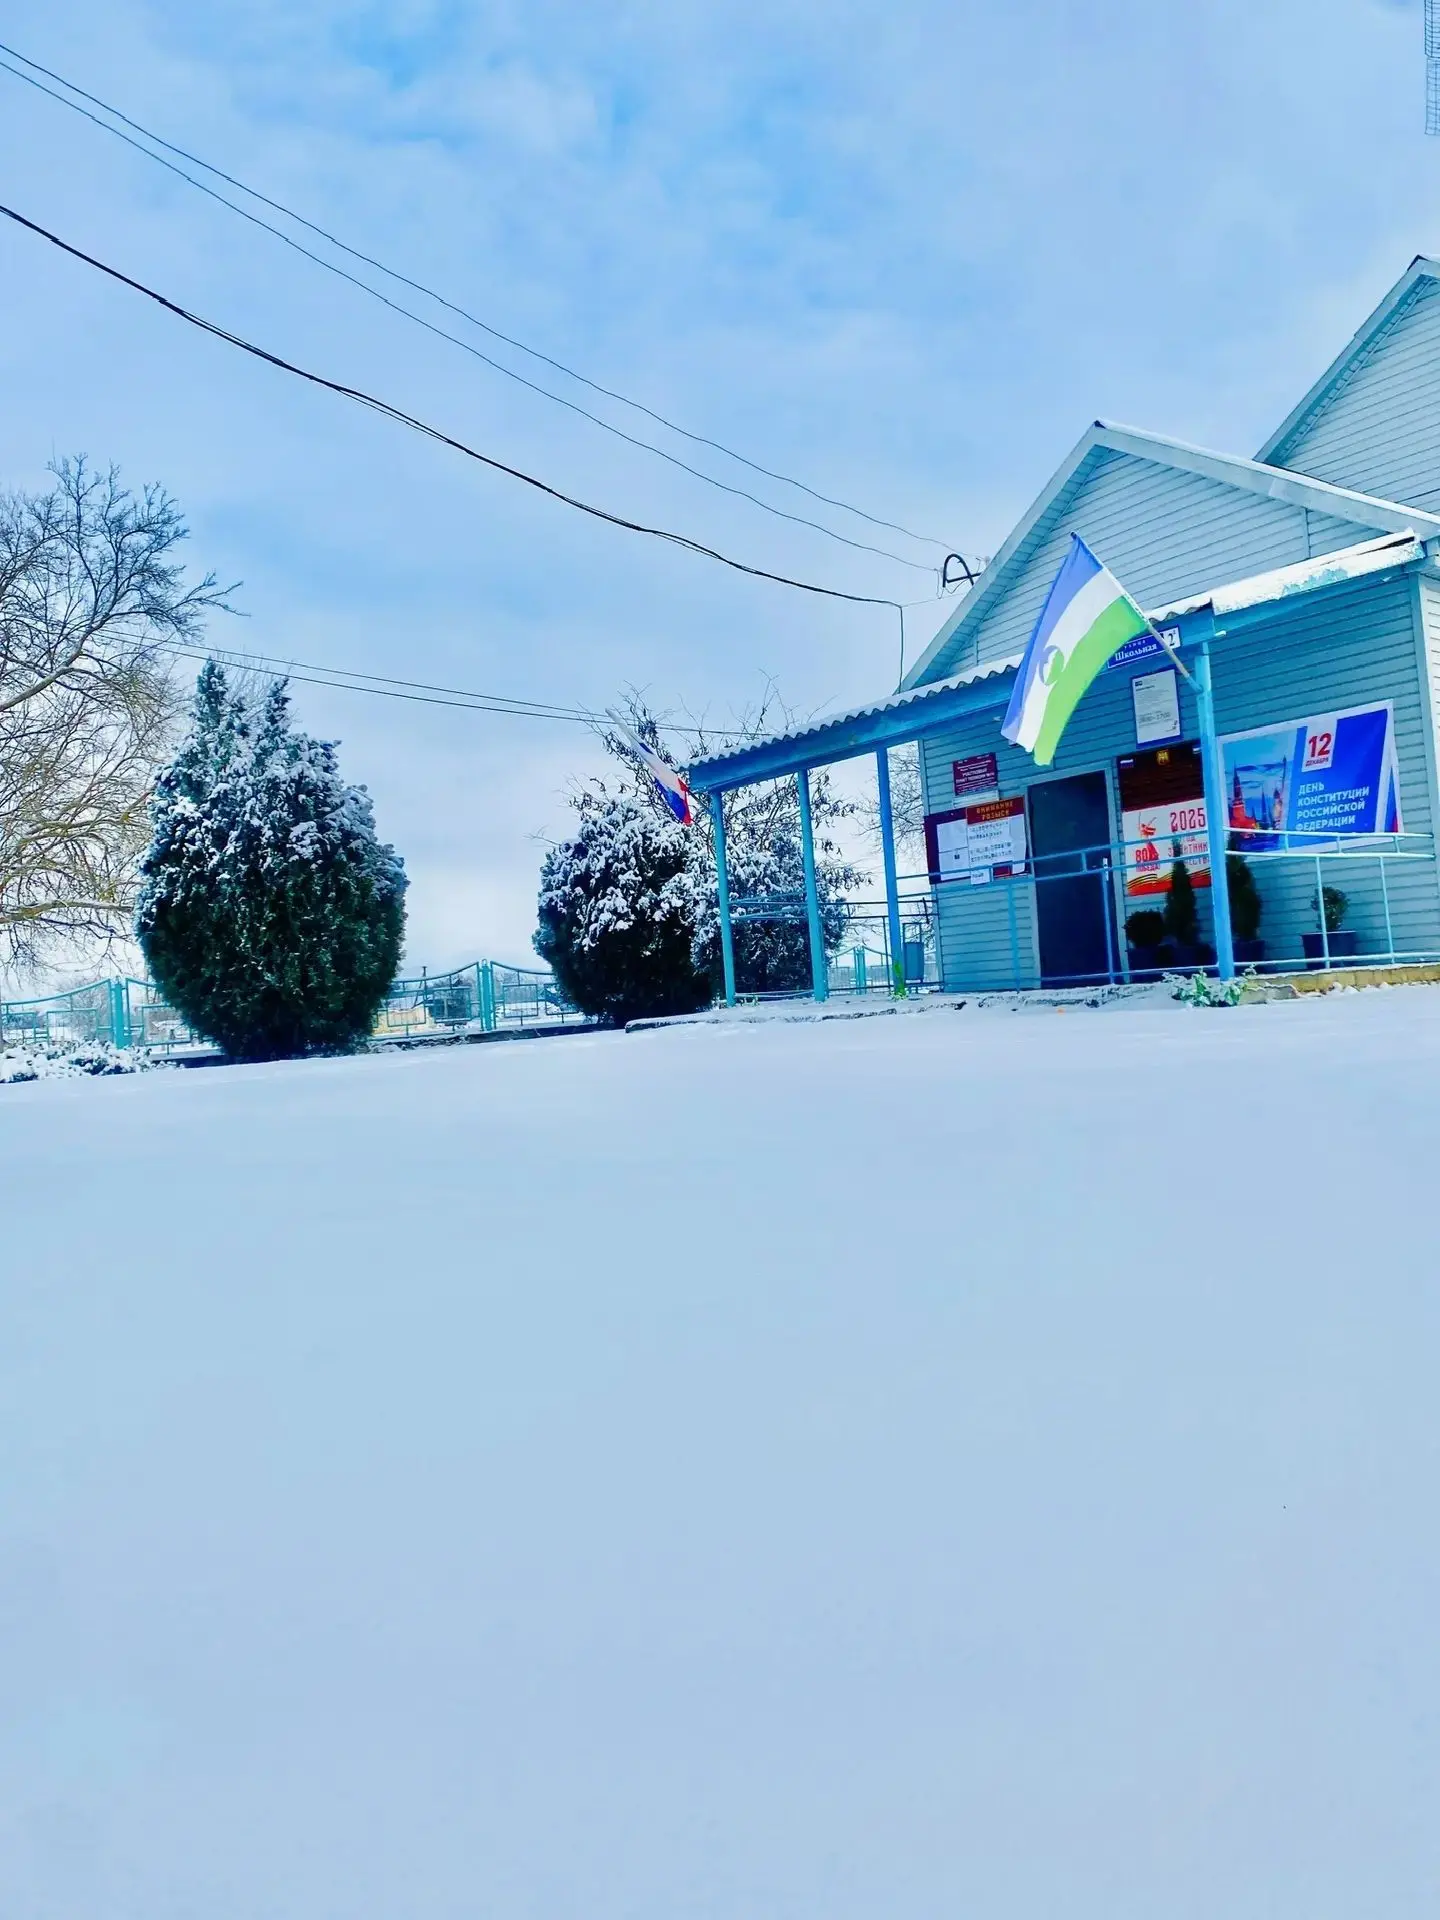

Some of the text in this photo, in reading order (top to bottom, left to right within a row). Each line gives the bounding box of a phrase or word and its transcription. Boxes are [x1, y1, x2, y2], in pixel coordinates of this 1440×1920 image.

[1115, 643, 1158, 661] Школьная
[1308, 732, 1332, 758] 12
[1305, 757, 1329, 767] ДЕКАБРЯ
[1297, 786, 1370, 807] КОНСТИТУЦИИ
[1299, 782, 1325, 796] ДЕНЬ
[1296, 798, 1366, 820] РОССИЙСКОЙ
[1170, 807, 1206, 832] 2025
[1295, 815, 1356, 832] ФЕДЕРАЦИИ
[1135, 847, 1149, 863] 80
